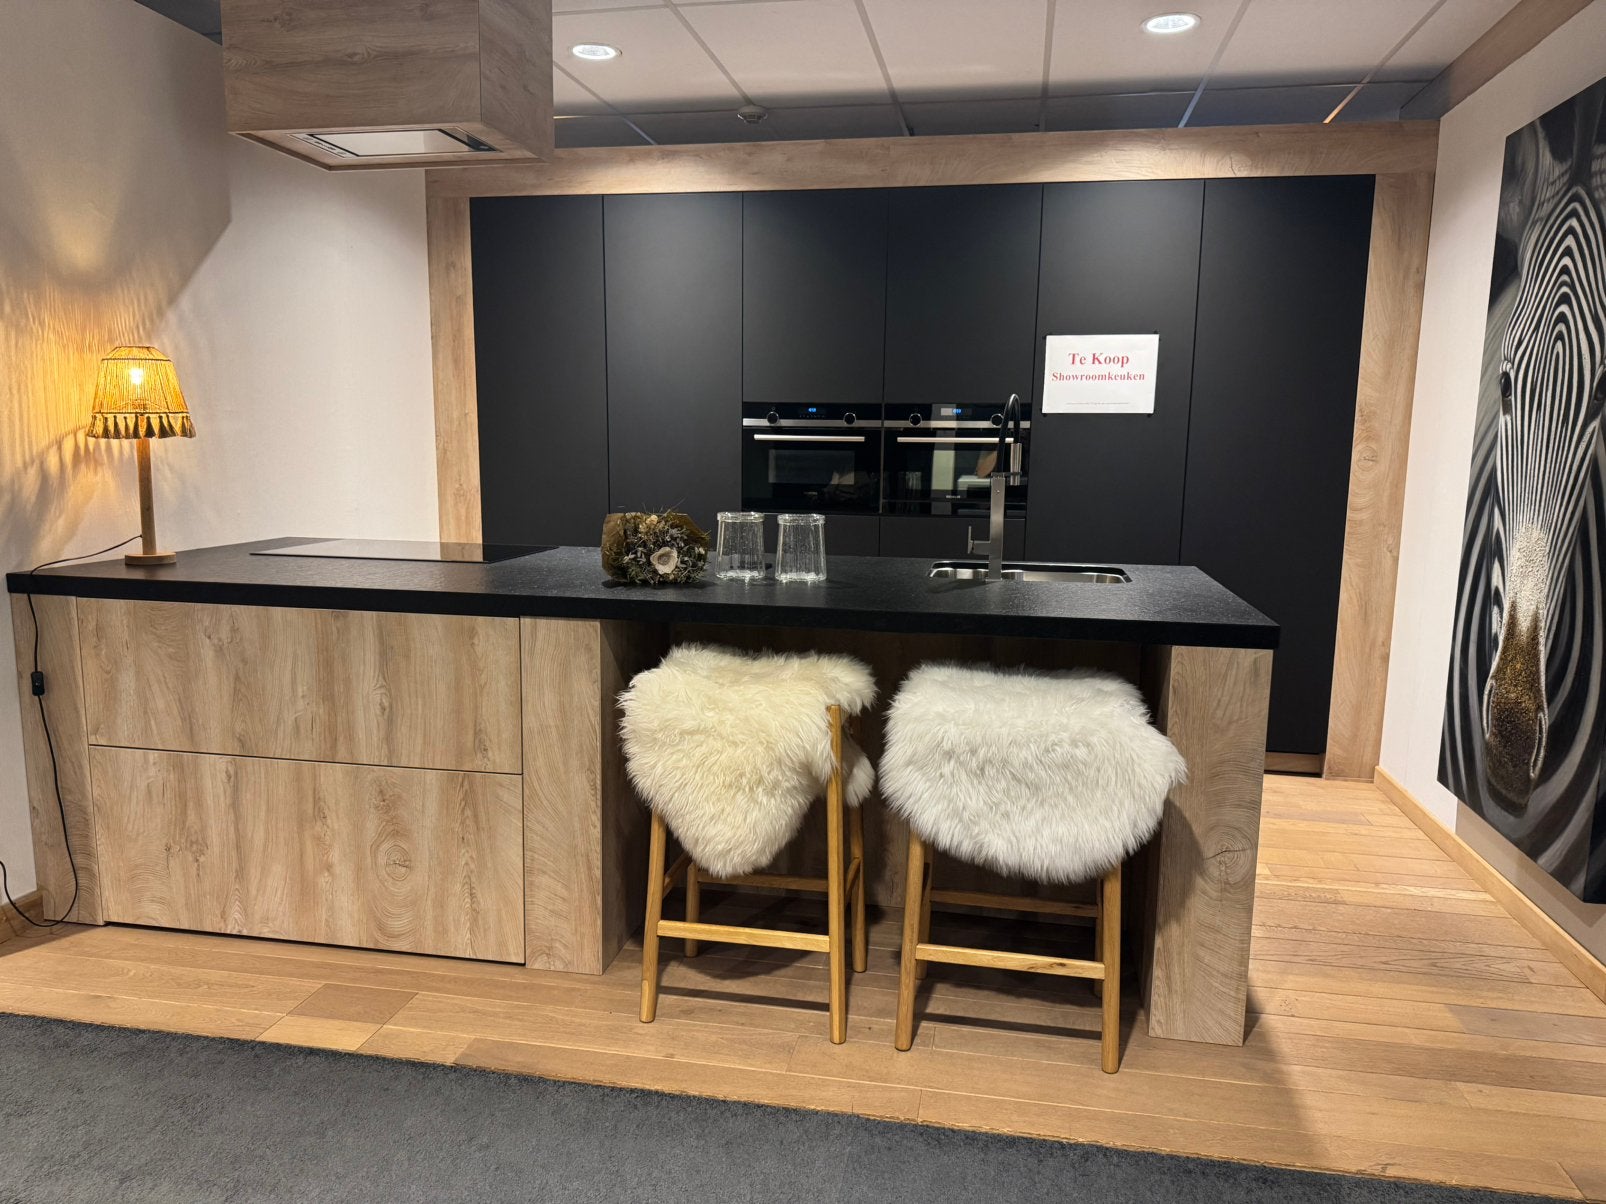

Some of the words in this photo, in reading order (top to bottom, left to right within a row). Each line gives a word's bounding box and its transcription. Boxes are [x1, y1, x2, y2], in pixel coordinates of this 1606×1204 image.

[1068, 352, 1087, 366] Te
[1091, 352, 1130, 368] Koop
[1051, 371, 1146, 382] Showroomkeuken
